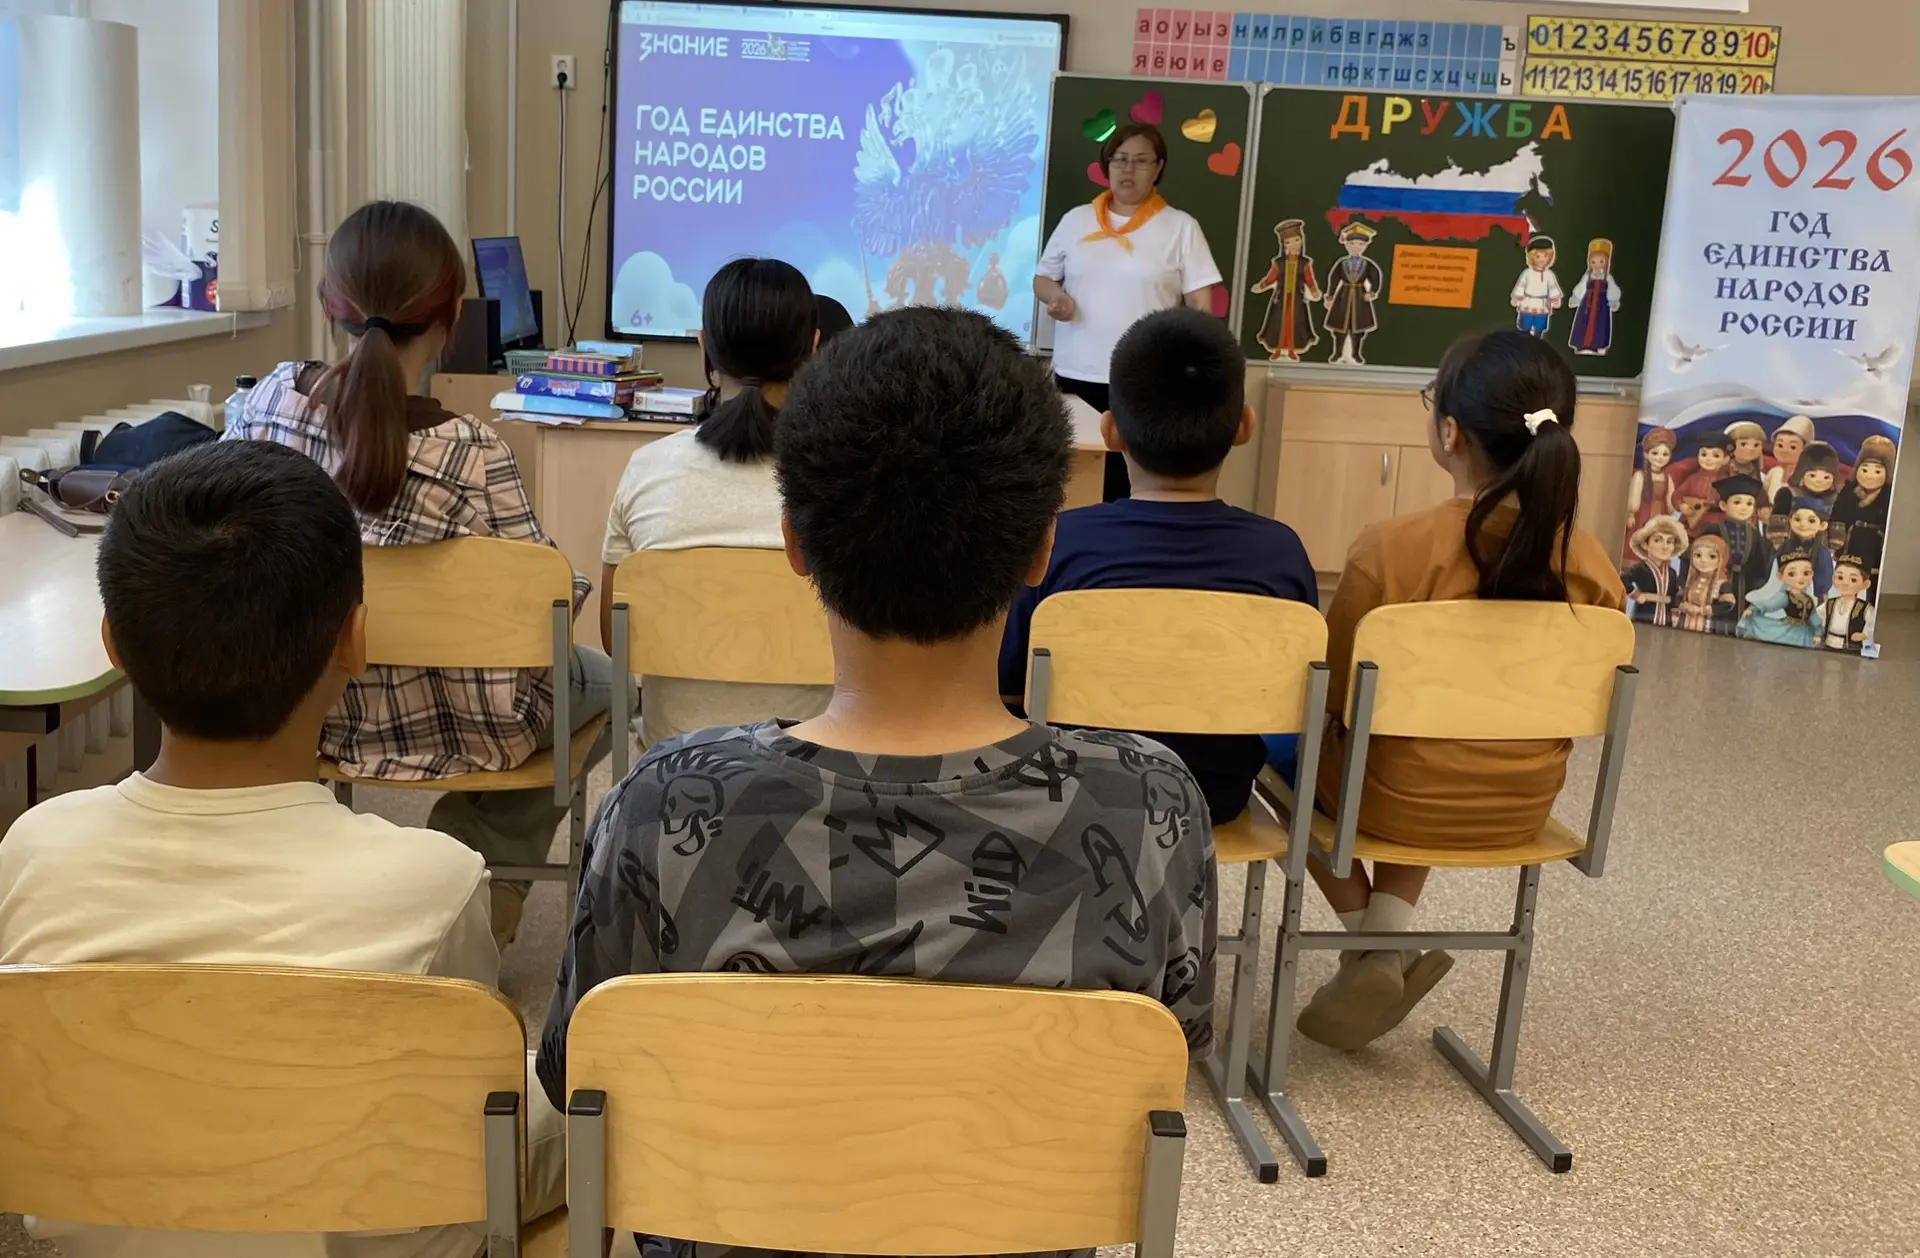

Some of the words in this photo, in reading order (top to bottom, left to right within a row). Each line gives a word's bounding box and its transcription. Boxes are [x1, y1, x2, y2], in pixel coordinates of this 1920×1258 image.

[1535, 24, 1549, 46] 0
[1553, 23, 1564, 48] 1
[1571, 24, 1587, 49] 2
[1593, 25, 1608, 51] 3
[1614, 26, 1630, 52] 4
[1636, 27, 1653, 52] 5
[1658, 28, 1674, 54] 6
[1681, 29, 1697, 54] 7
[1701, 30, 1717, 56] 8
[1723, 31, 1739, 56] 9
[1743, 32, 1770, 58] 10
[1529, 64, 1547, 90] 11
[1550, 65, 1570, 90] 12
[1573, 66, 1593, 91] 13
[1597, 68, 1617, 92] 14
[1622, 69, 1643, 93] 15
[1646, 70, 1666, 94] 16
[1670, 71, 1690, 94] 17
[1693, 72, 1713, 94] 18
[1716, 73, 1737, 94] 19
[1741, 74, 1764, 94] 20
[636, 105, 690, 136] ГОД
[700, 108, 845, 140] ЕДИНСТВА
[1330, 95, 1572, 141] ДРУЖБА
[635, 140, 766, 173] НАРОДОВ
[1712, 128, 1913, 191] 2026
[633, 174, 743, 204] РОССИИ
[1768, 211, 1832, 239] ГОД
[1704, 242, 1893, 273] ЕДИНСТВА
[1714, 277, 1870, 309] НАРОДОВ
[631, 308, 653, 328] 6+
[1718, 311, 1858, 341] РОССИИ
